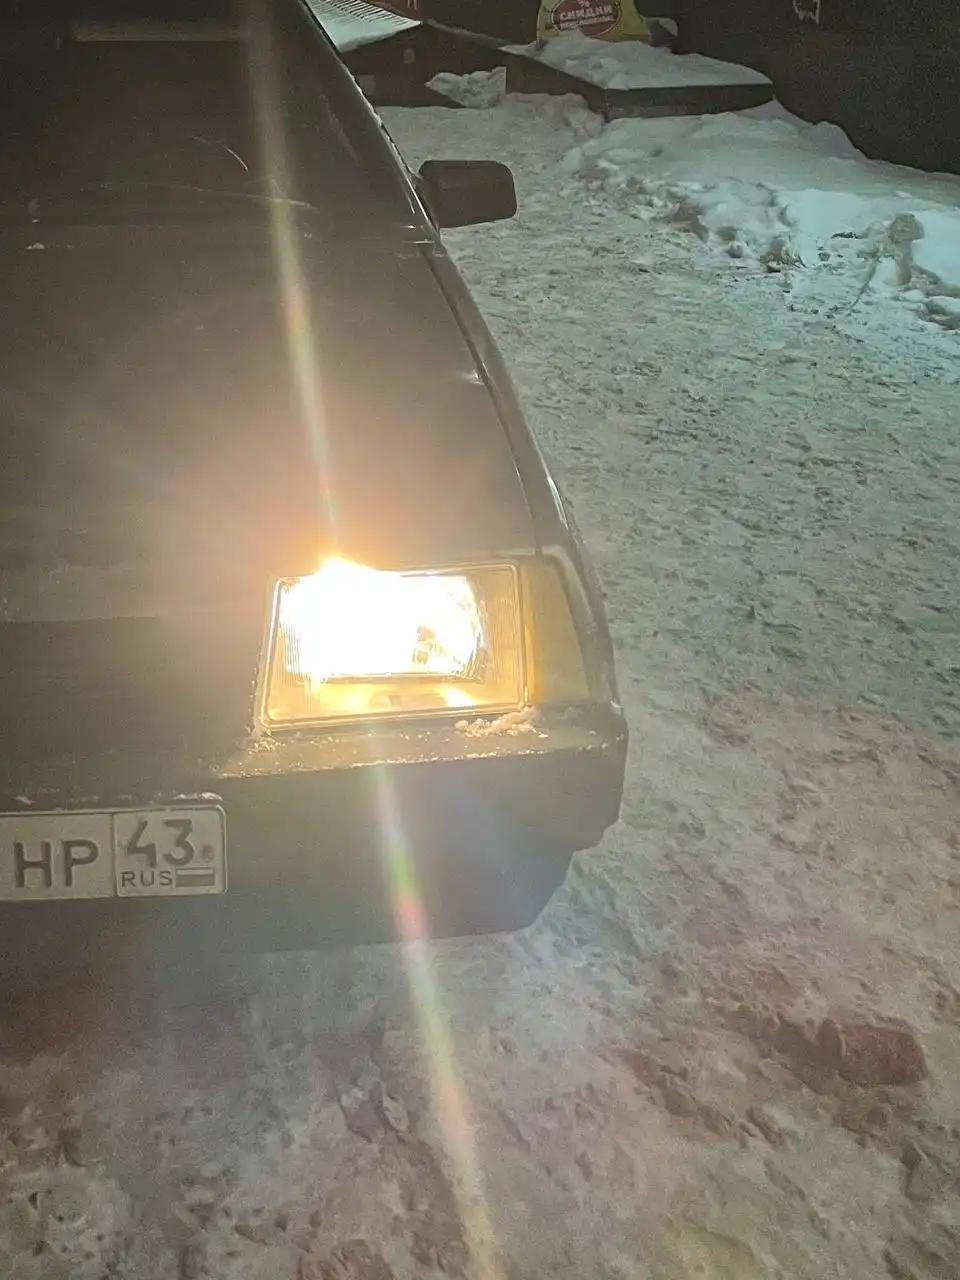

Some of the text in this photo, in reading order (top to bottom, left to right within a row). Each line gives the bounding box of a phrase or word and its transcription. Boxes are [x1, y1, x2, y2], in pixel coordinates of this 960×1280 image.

[559, 5, 613, 20] СКИДКИ
[126, 819, 195, 867] 43
[121, 871, 173, 888] RUS
